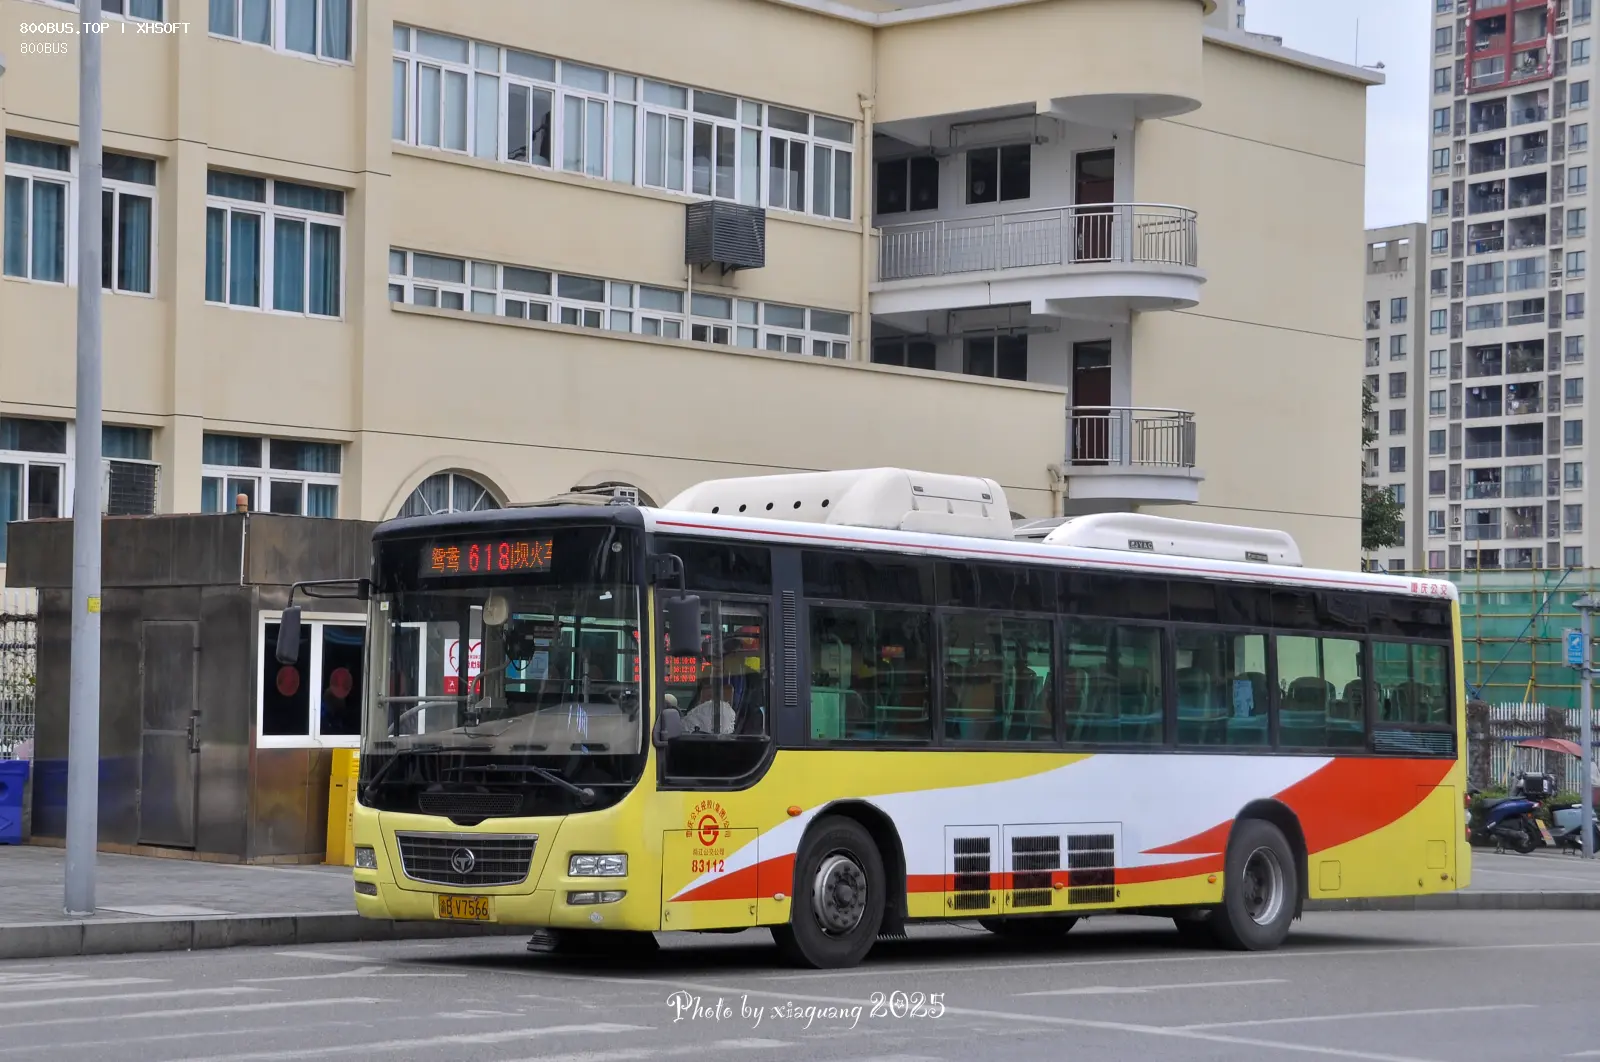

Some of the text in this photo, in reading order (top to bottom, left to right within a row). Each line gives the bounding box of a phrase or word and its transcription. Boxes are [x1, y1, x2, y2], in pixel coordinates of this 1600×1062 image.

[468, 542, 511, 571] 618
[1410, 582, 1448, 596] 重庆公交
[691, 859, 725, 873] 83112
